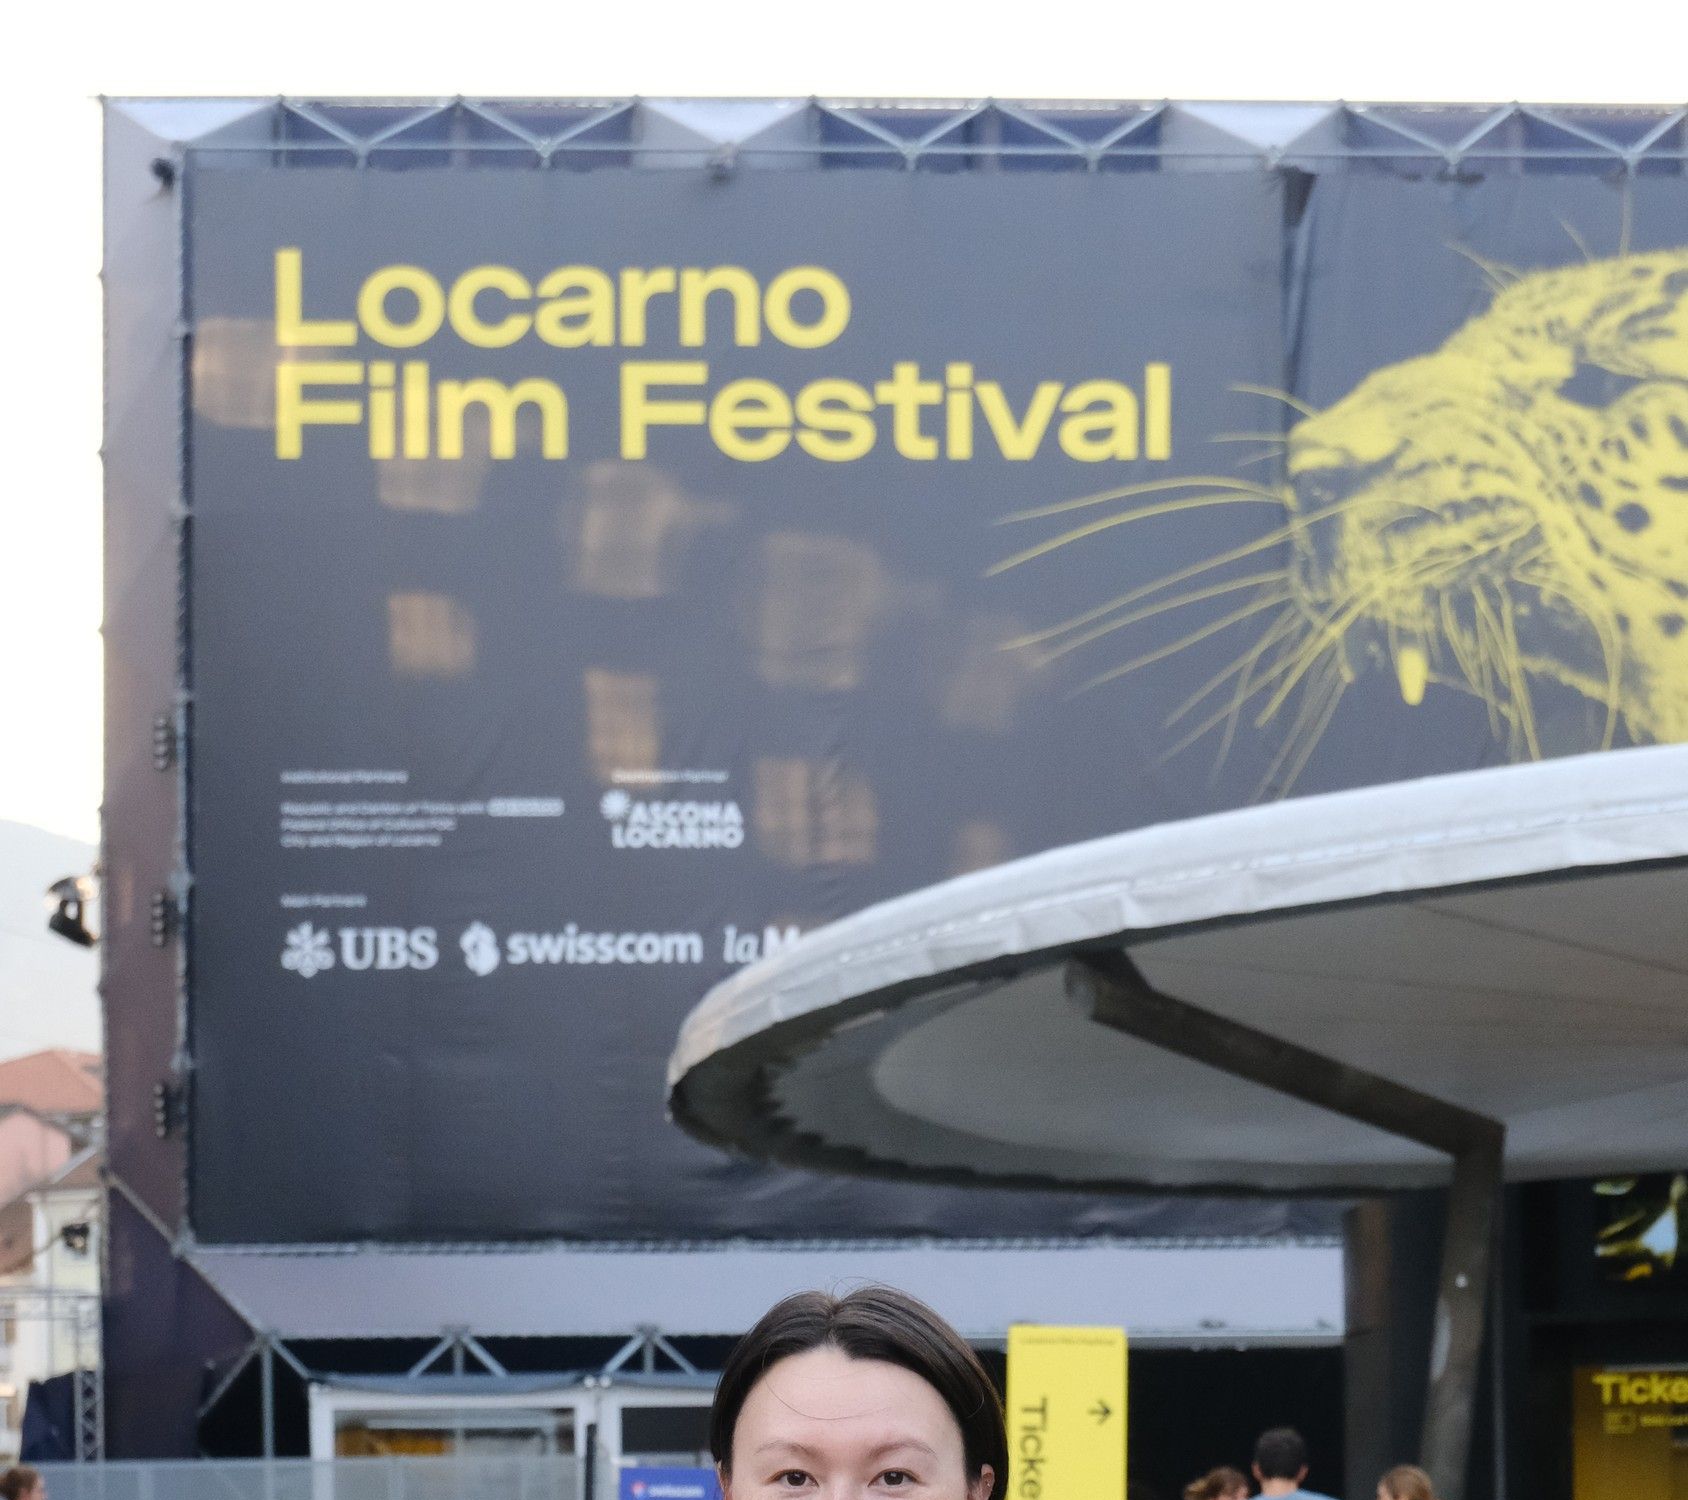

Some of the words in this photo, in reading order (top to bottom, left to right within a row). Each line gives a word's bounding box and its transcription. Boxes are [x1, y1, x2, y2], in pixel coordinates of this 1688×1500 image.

[275, 249, 850, 348] Locarno
[275, 360, 568, 461] Film
[620, 361, 1171, 463] Festival
[629, 800, 744, 827] ASCONA
[611, 824, 744, 849] LOCARNO
[338, 926, 439, 970] UBS
[506, 922, 705, 965] swisscom
